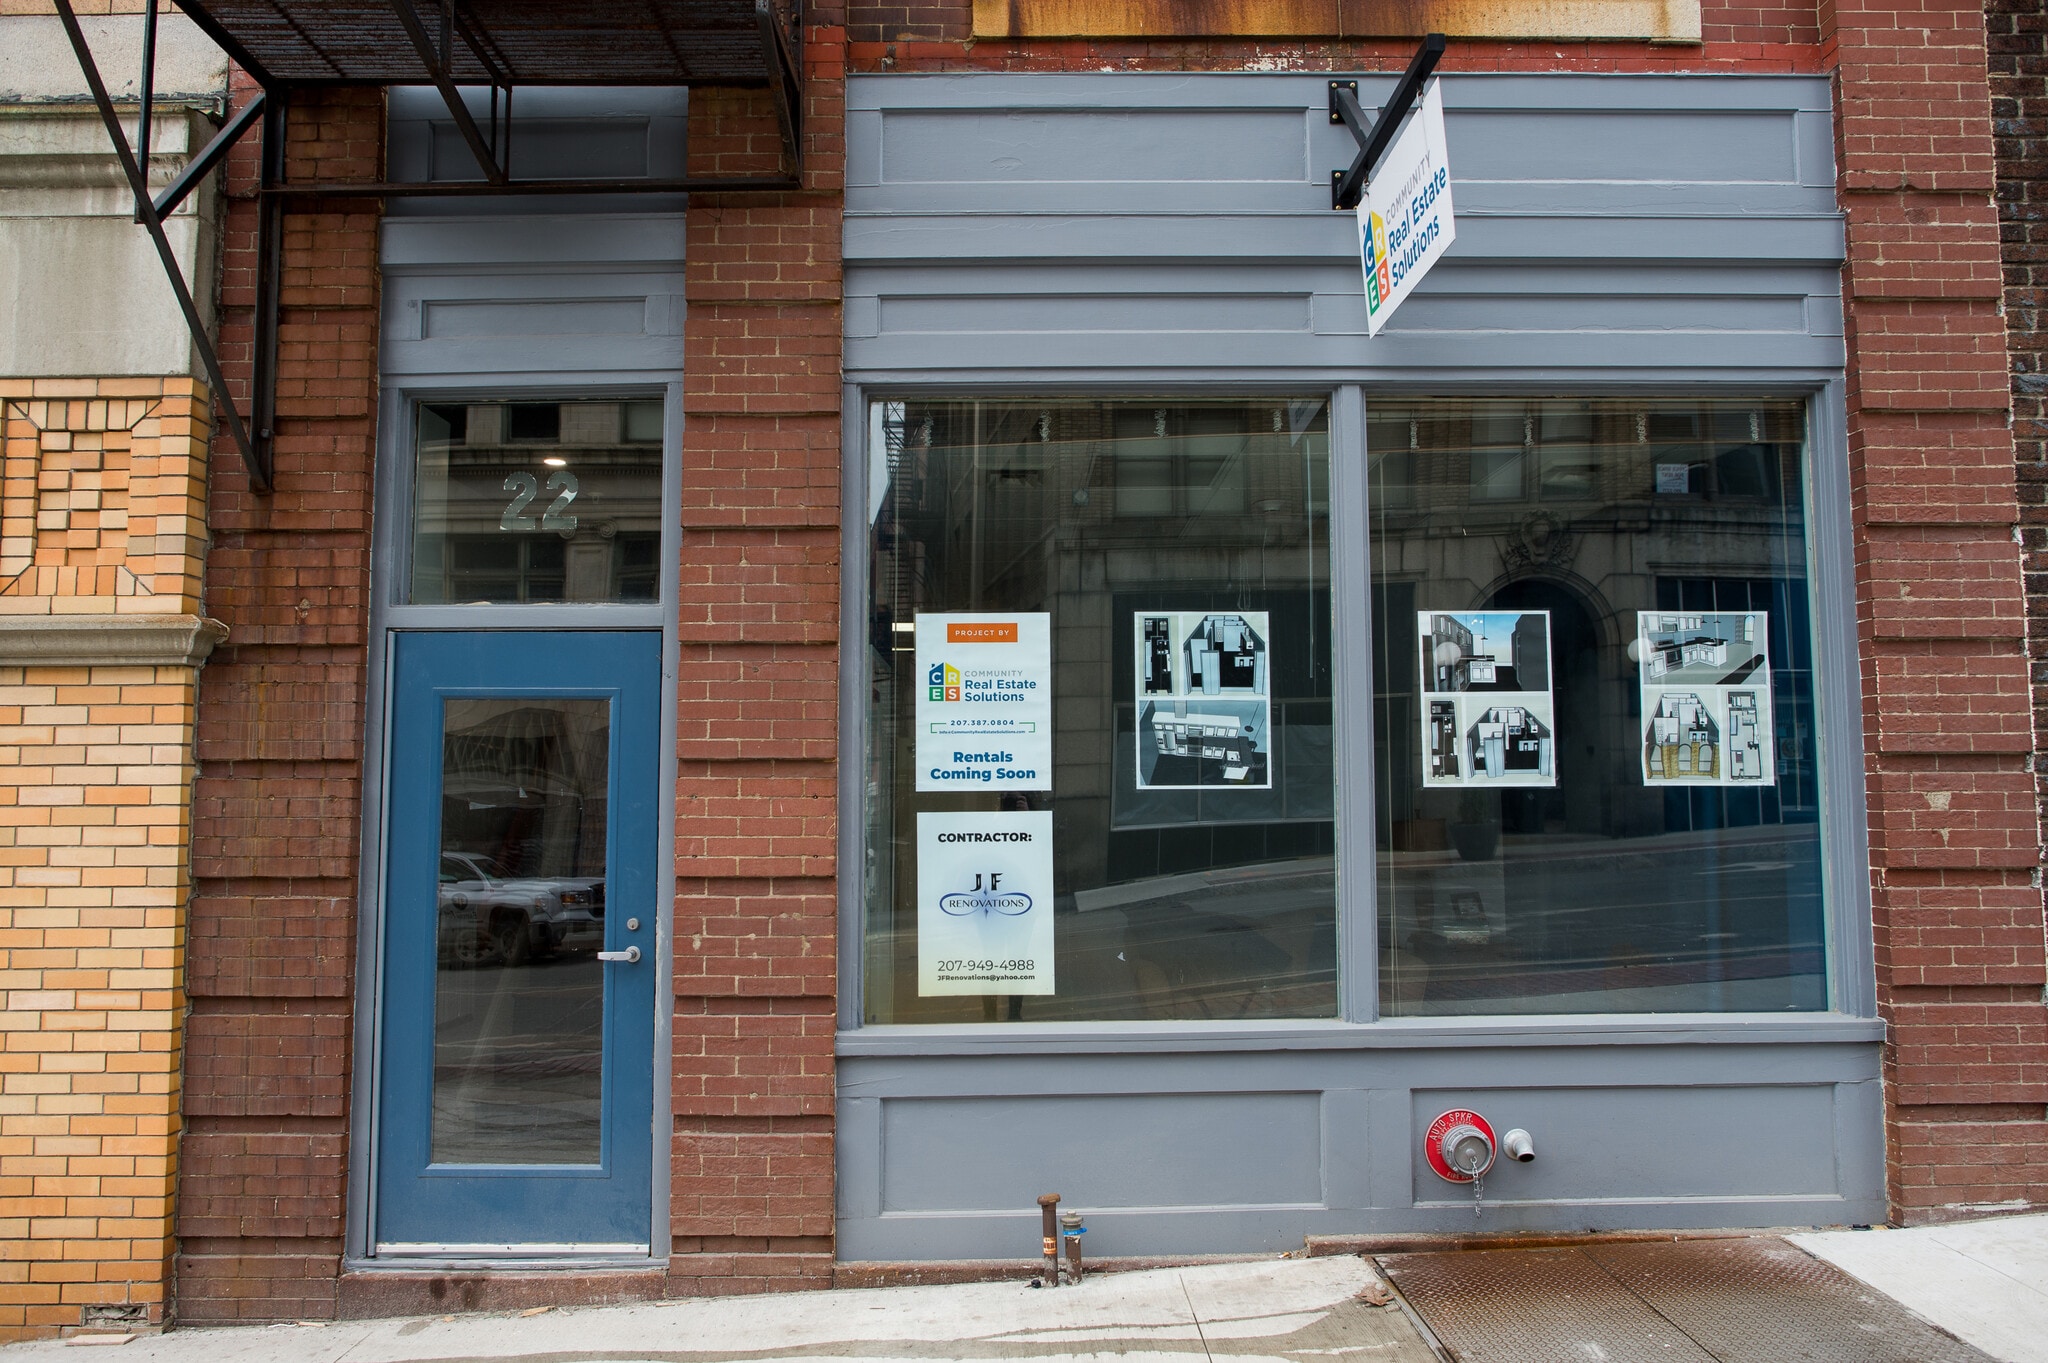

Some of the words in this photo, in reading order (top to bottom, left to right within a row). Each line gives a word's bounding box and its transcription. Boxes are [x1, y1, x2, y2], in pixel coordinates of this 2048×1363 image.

[1385, 150, 1431, 225] COMMUNITY
[1388, 209, 1412, 255] Real
[1412, 166, 1446, 226] Estate
[1392, 214, 1440, 288] Solutions
[499, 470, 579, 531] 22
[955, 629, 995, 637] PROJECT
[965, 679, 992, 689] Real
[997, 679, 1037, 689] Estate
[965, 691, 1025, 702] Solutions
[953, 751, 1013, 763] Rentals
[930, 767, 992, 782] Coming
[996, 768, 1036, 779] Soon
[938, 832, 1032, 843] CONTRACTOR:
[949, 898, 1024, 908] RENOVATIONS
[937, 959, 1035, 972] 207-949-4988
[937, 973, 1036, 982] JFRenovations@yahoo.com
